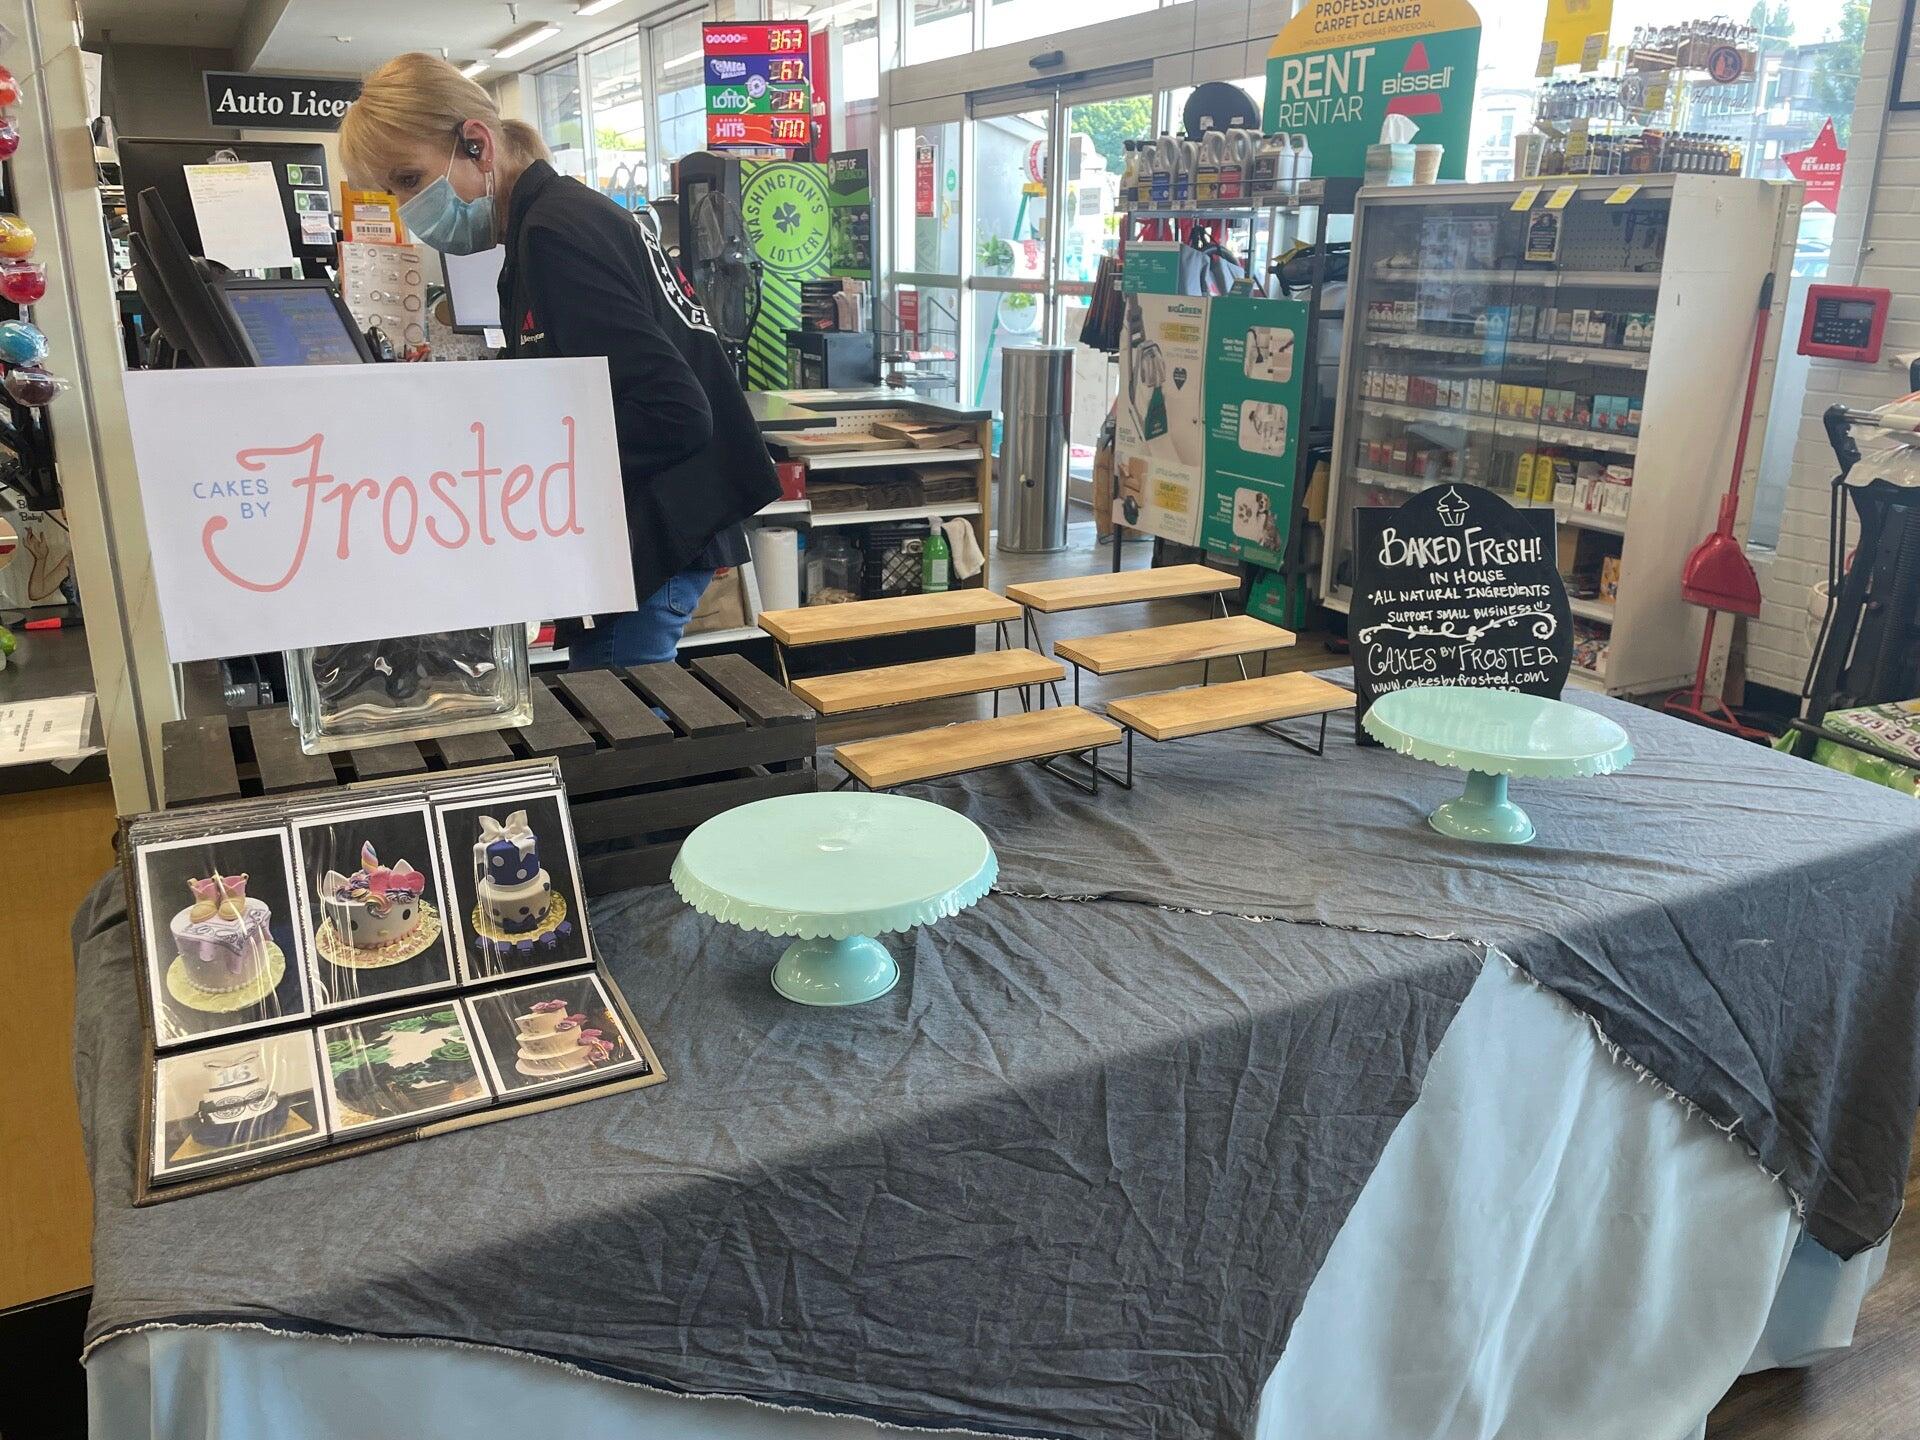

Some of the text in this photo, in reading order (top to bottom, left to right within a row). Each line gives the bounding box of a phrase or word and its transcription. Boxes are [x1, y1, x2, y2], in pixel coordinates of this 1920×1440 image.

[1314, 4, 1422, 34] CARPET CLEANER
[1315, 0, 1420, 18] PROFESSI
[780, 61, 804, 80] 67
[1281, 47, 1376, 101] RENT
[216, 88, 284, 115] Auto
[712, 94, 747, 109] LOTTO
[787, 91, 805, 110] 14
[1278, 96, 1364, 128] RENTAR
[716, 122, 746, 138] HIT5
[1801, 163, 1842, 172] REWARDS
[746, 173, 824, 243] WASHINGTON'S
[769, 227, 824, 263] LOTTERY
[193, 479, 269, 499] CAKES
[202, 416, 585, 593] Frosted
[240, 502, 271, 519] BY
[1379, 526, 1542, 568] BAKED FRESH!
[1430, 568, 1506, 585] IN HOUSE
[1400, 587, 1461, 602] NATURAL
[1465, 582, 1550, 599] INGREDIENTS
[1387, 604, 1532, 624] SUPPORT SMALL BUSINESS
[1368, 642, 1558, 676] CAKES BY FROSTED
[1371, 669, 1550, 694] www.cakesbyfrosted.com
